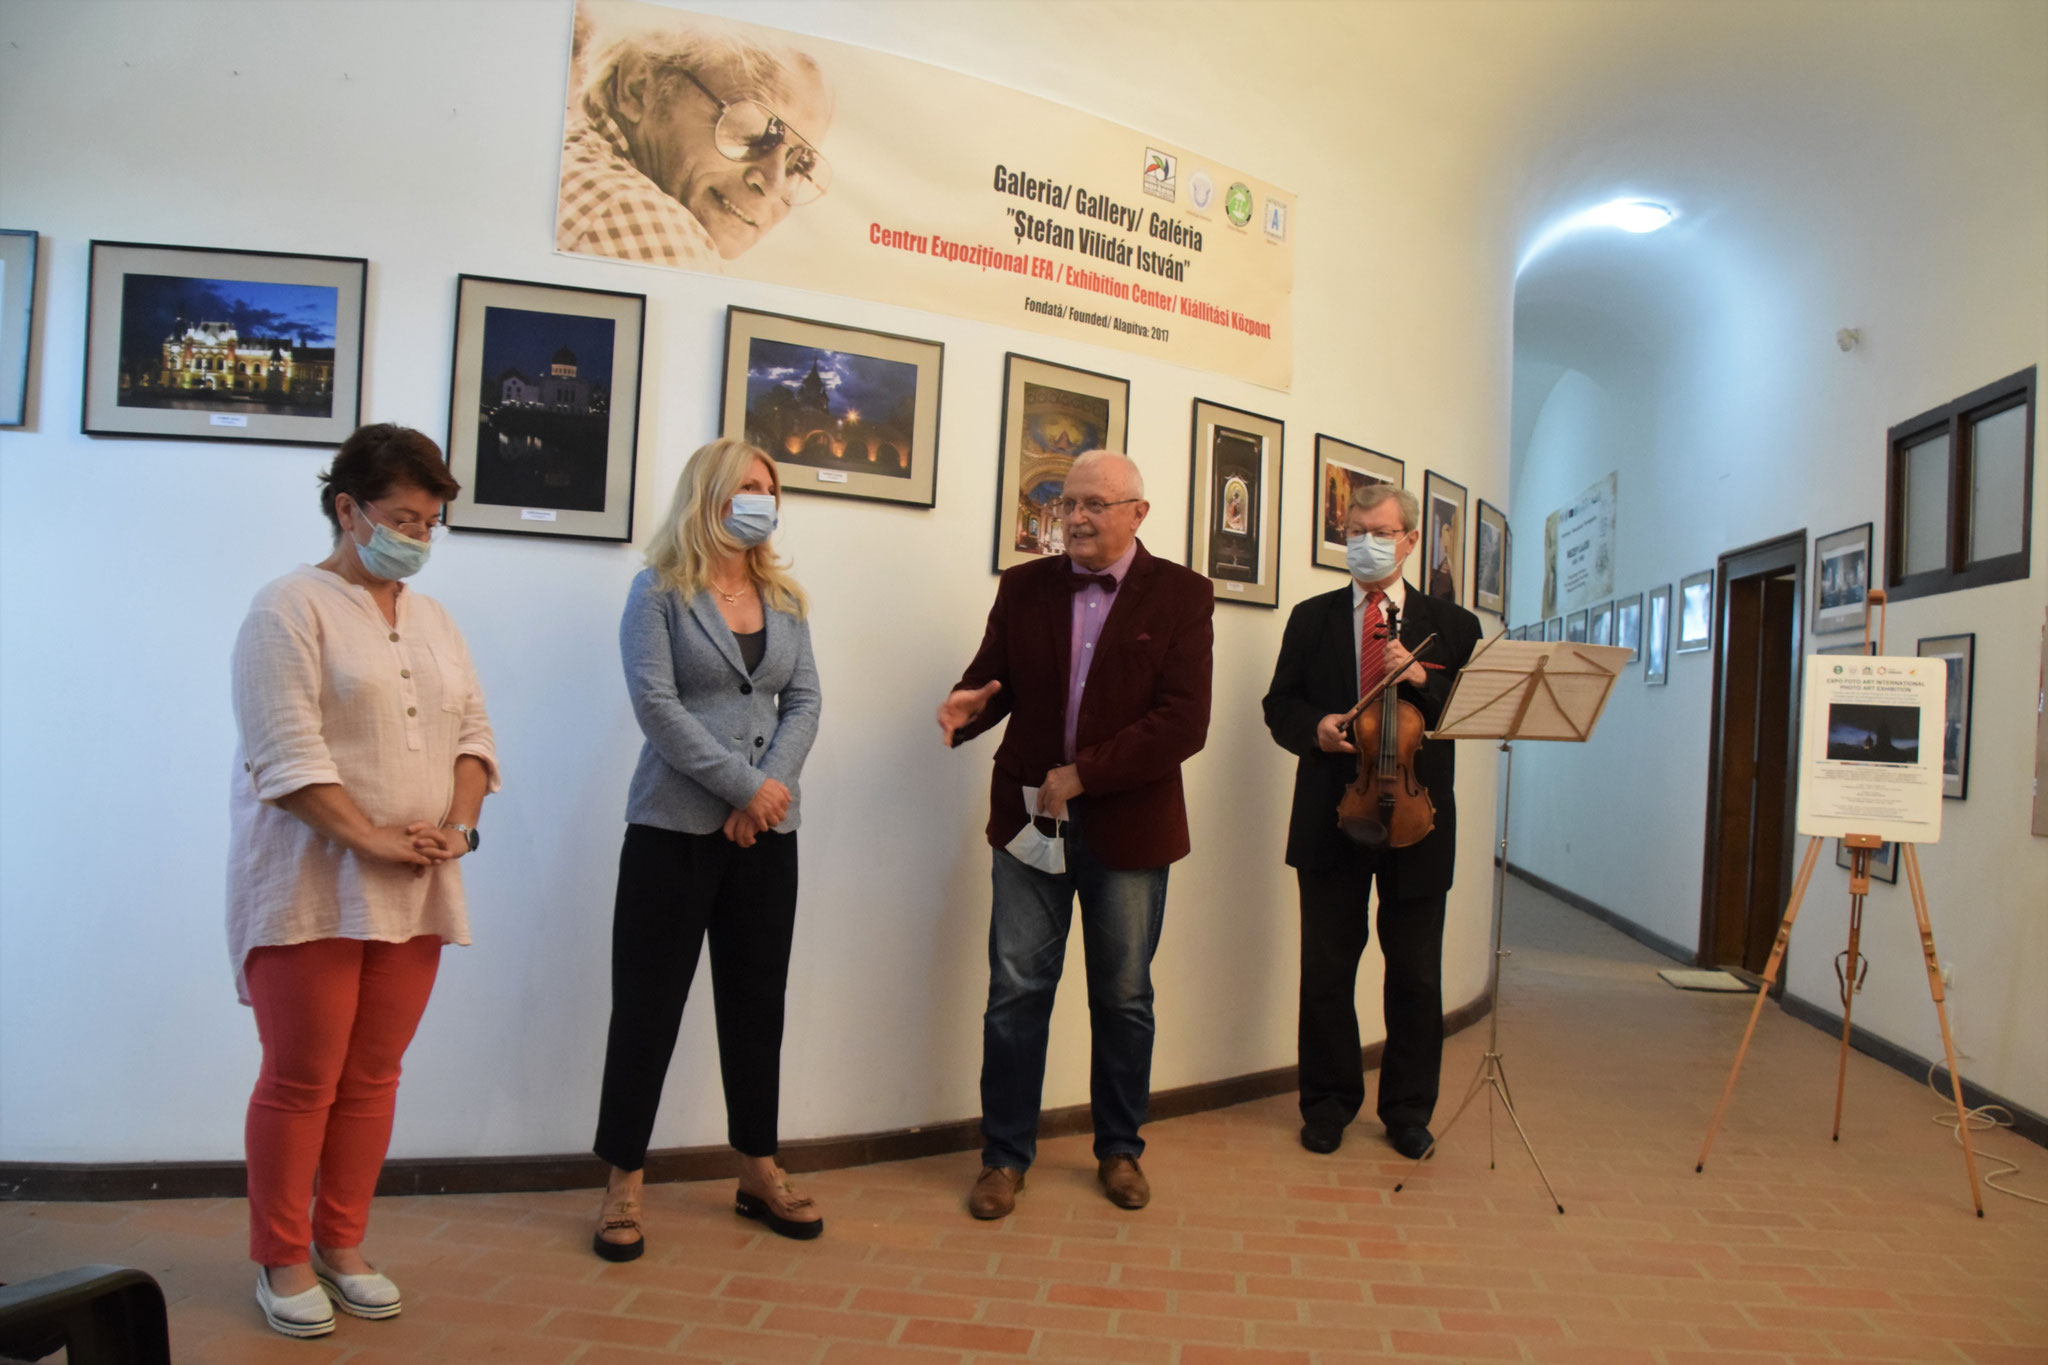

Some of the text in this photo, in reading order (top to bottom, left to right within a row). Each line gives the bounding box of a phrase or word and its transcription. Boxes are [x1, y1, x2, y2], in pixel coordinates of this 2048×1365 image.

[993, 164, 1072, 210] Galeria/
[1075, 188, 1144, 232] Gallery/
[1149, 212, 1203, 252] Galéria
[1078, 227, 1133, 267] Vilidár
[869, 222, 928, 254] Centru
[931, 235, 1029, 275] Expozițional
[1031, 256, 1053, 281] EFA
[1065, 265, 1130, 300] Exhibition
[1132, 283, 1177, 313] Center/
[1180, 296, 1229, 327] Kiállítási
[1231, 311, 1271, 340] Központ
[1069, 306, 1112, 329] Founded/
[1151, 326, 1169, 342] 2017
